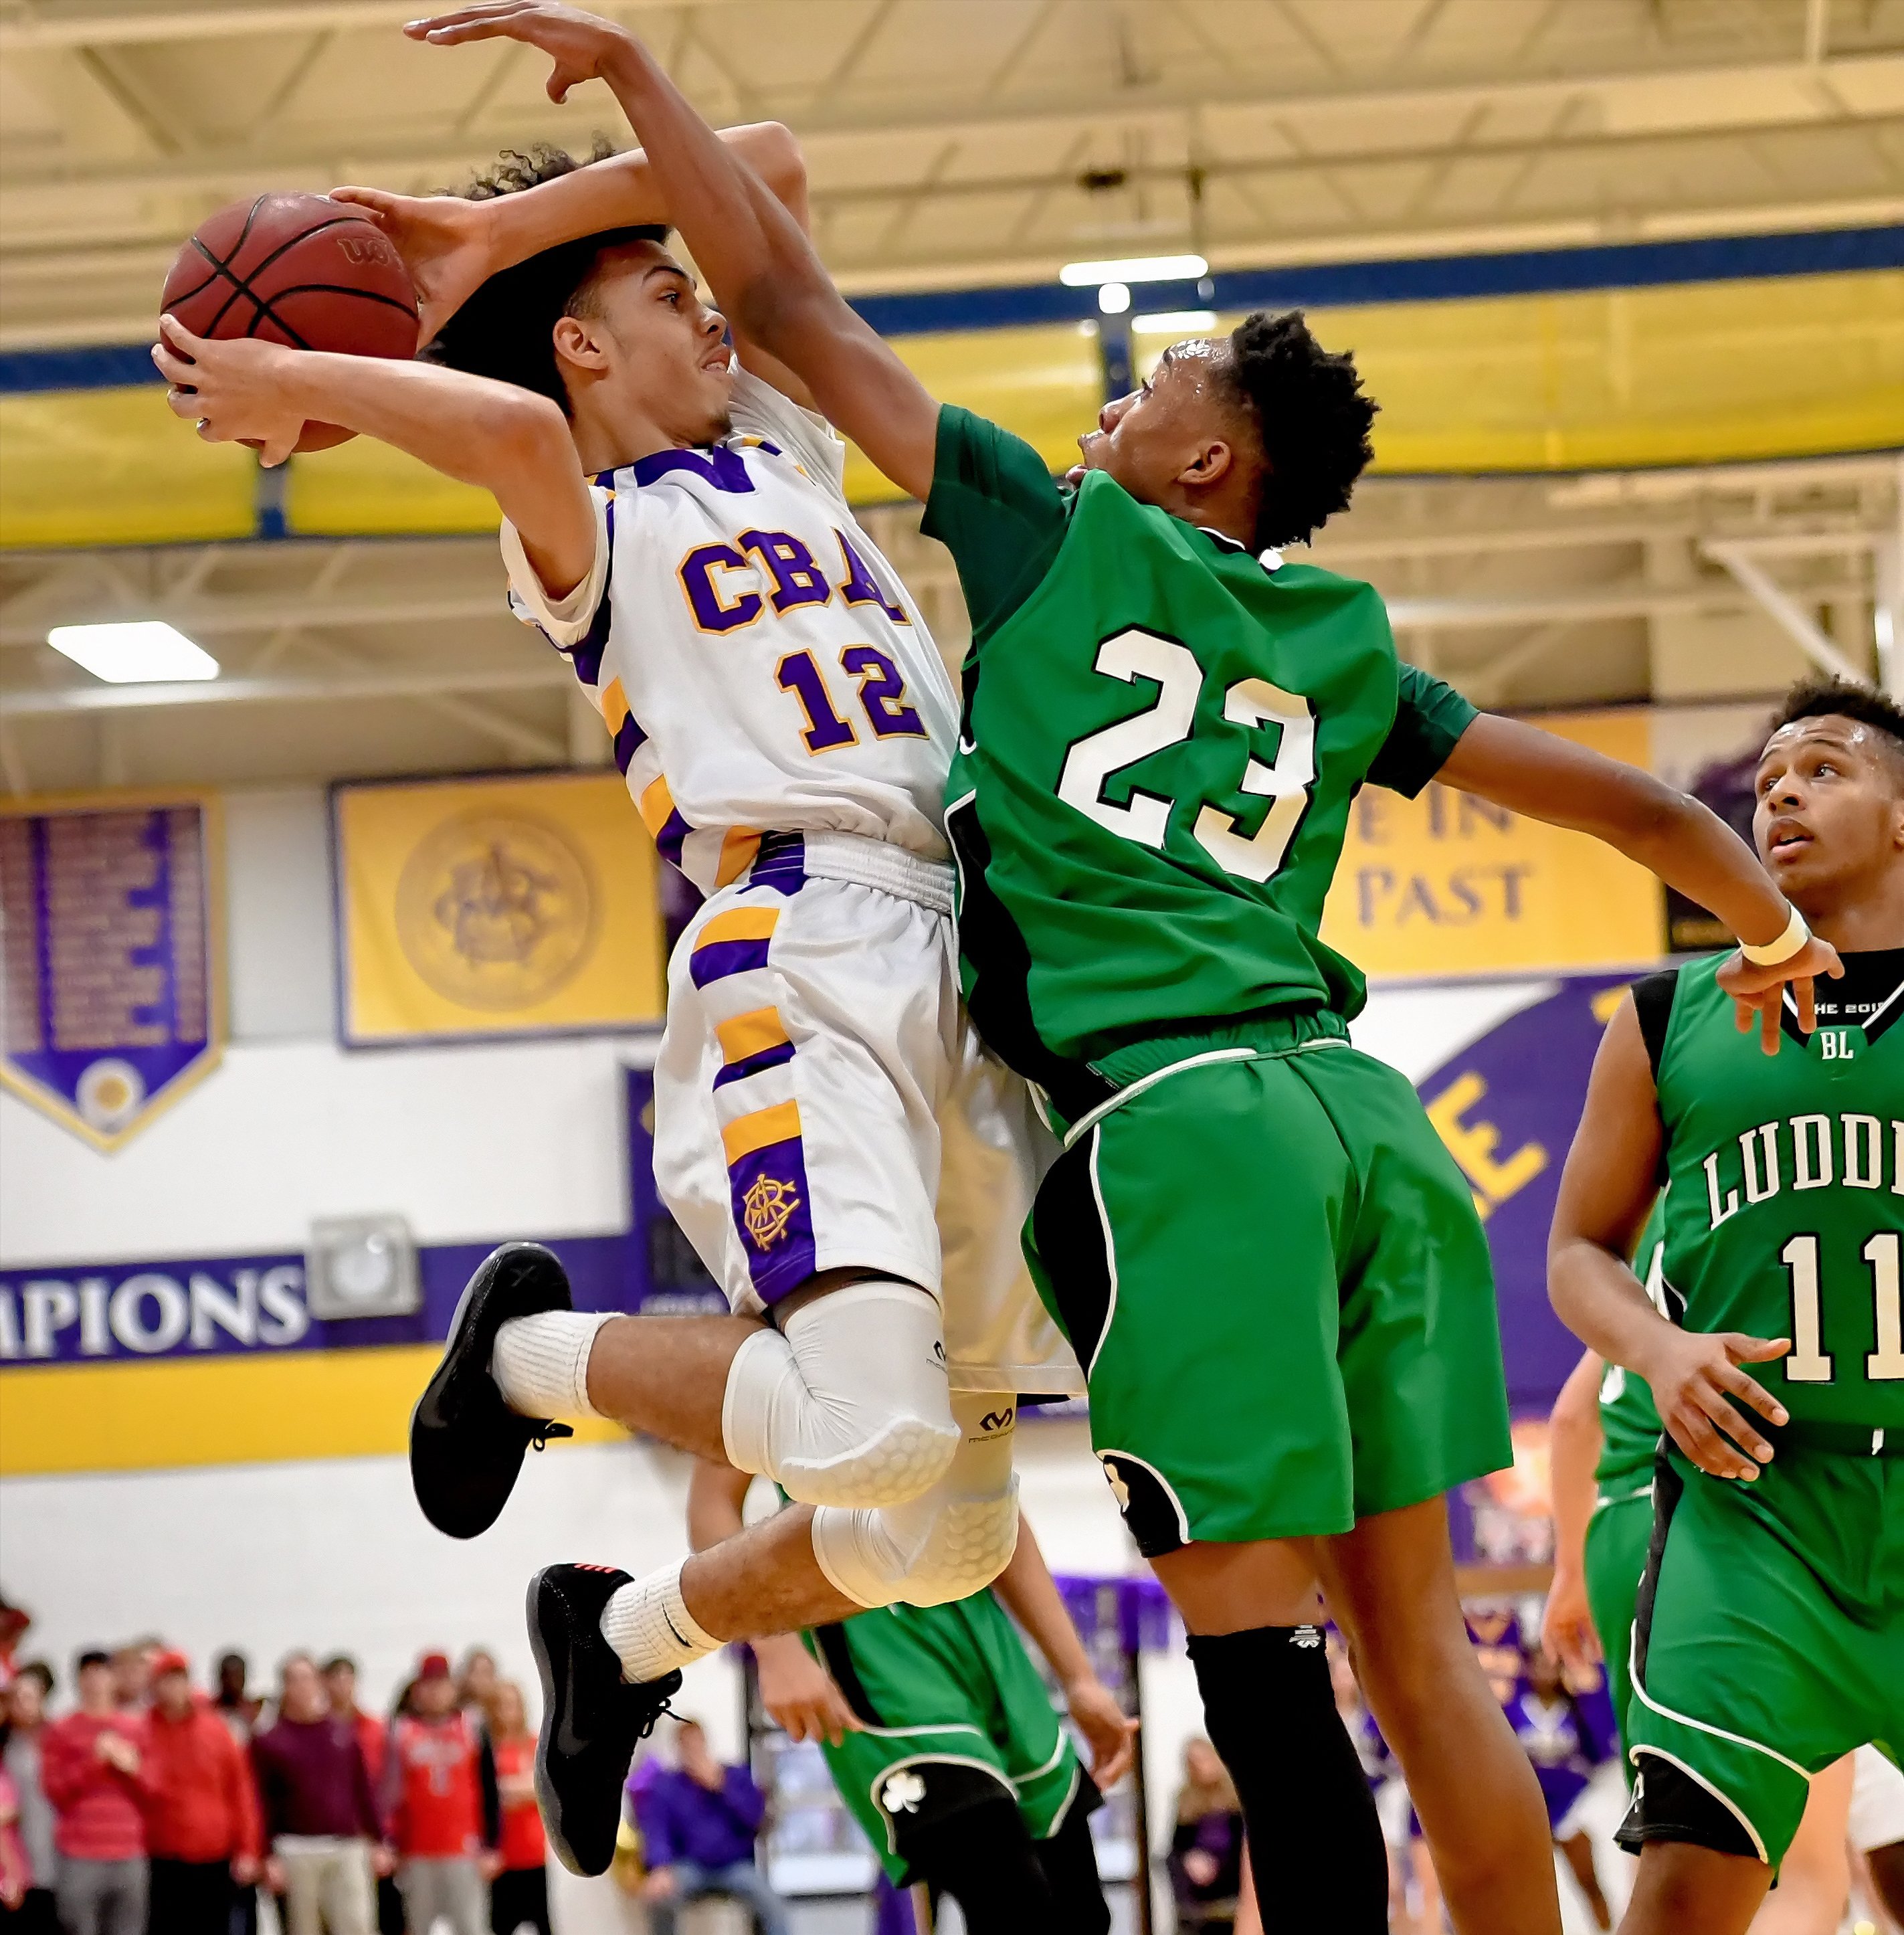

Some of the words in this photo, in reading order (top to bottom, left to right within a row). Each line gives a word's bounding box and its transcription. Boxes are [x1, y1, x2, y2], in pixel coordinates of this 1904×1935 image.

[676, 527, 912, 636] CBA
[773, 644, 930, 757] 12
[1053, 622, 1321, 884] 23
[1357, 783, 1393, 846] E
[1426, 778, 1515, 840] IN
[1357, 863, 1536, 928] PAST
[1814, 1002, 1838, 1015] HE
[1820, 1030, 1854, 1061] BL
[1778, 1232, 1904, 1382] 11
